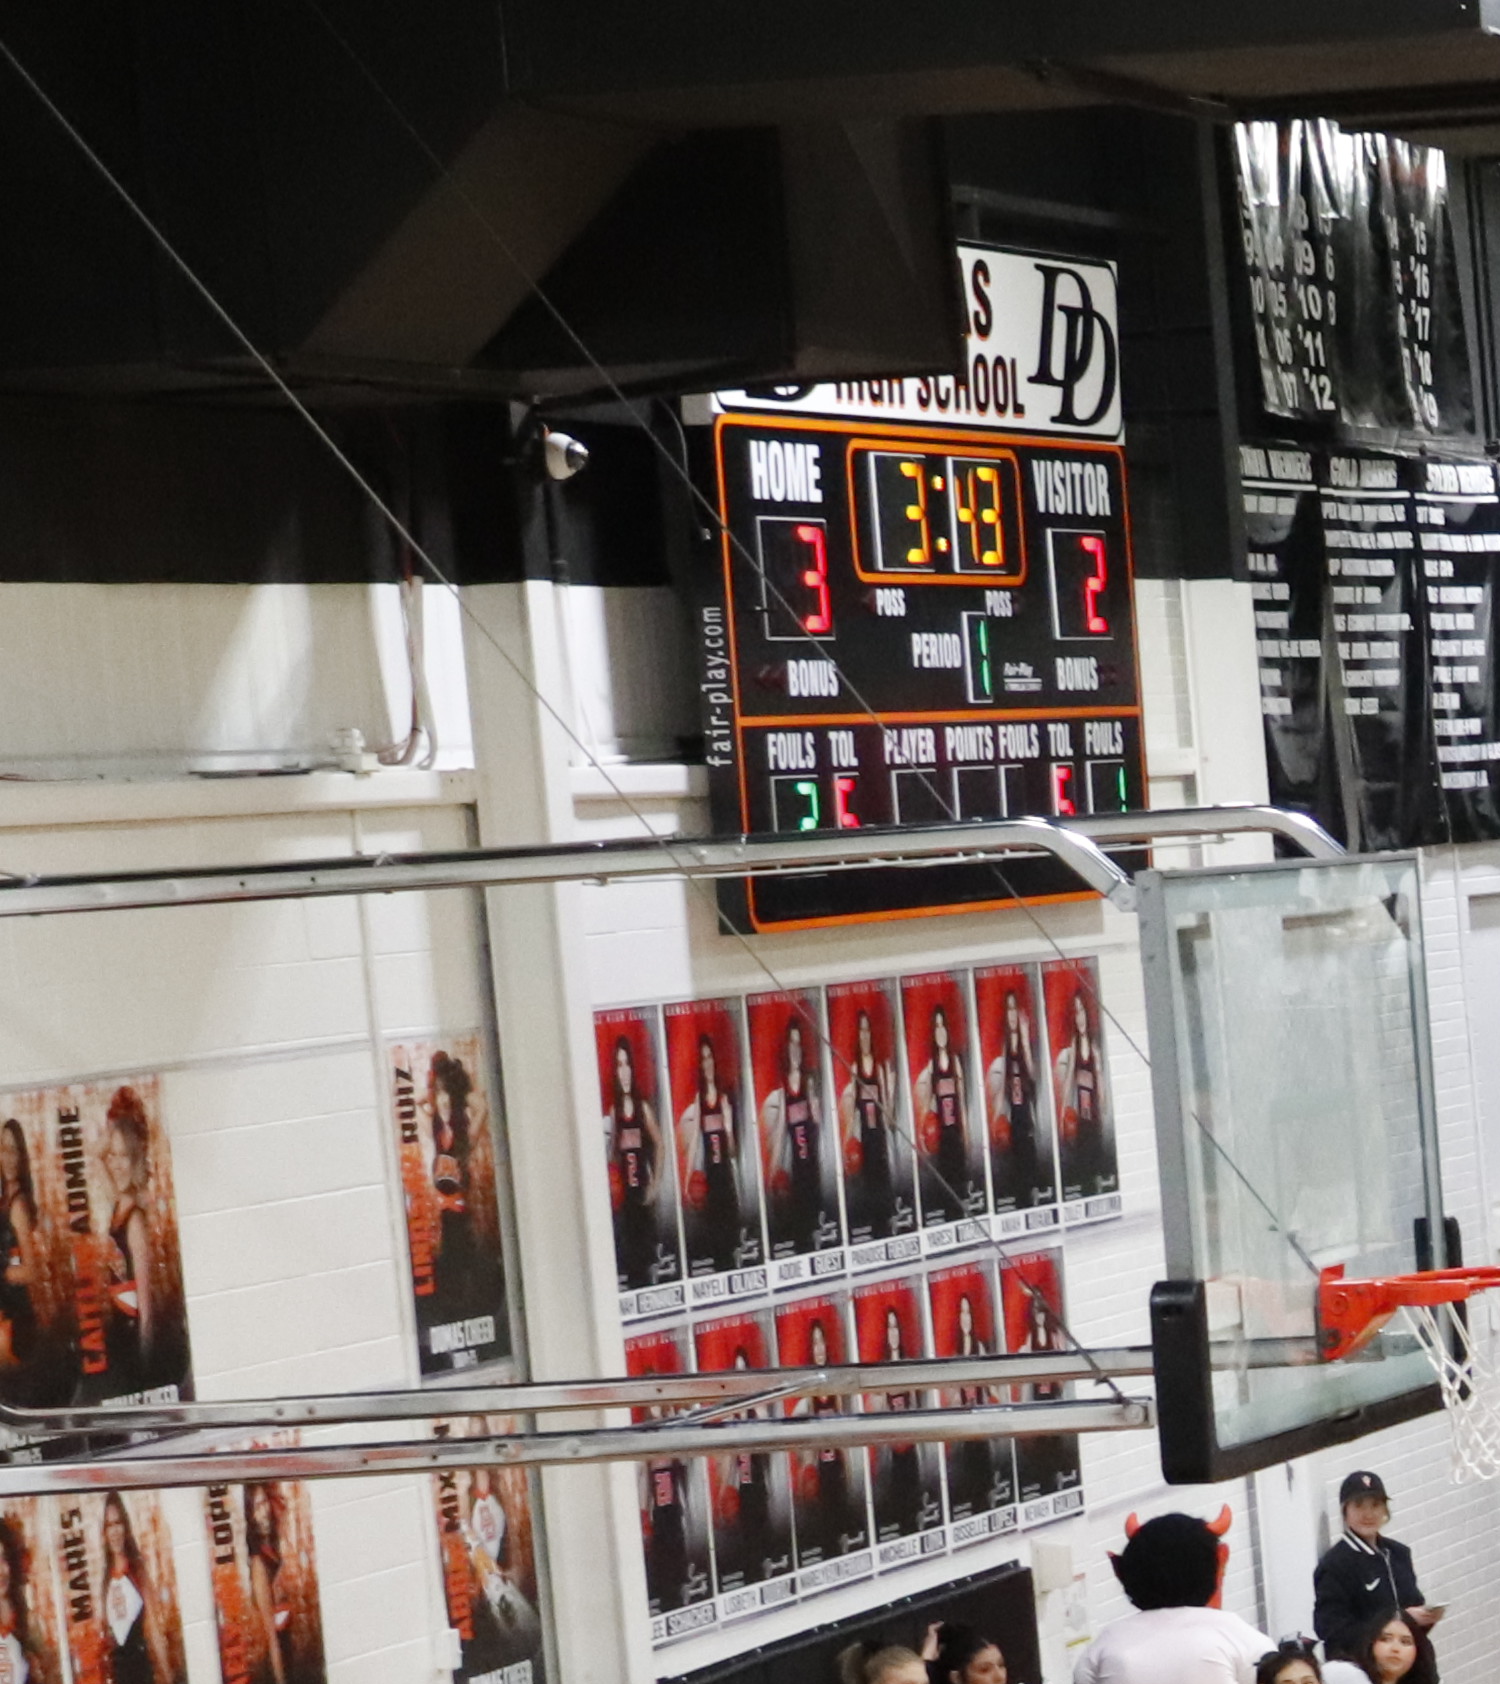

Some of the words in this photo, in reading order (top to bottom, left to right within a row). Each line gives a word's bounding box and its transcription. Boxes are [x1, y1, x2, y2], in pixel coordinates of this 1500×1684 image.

[1292, 277, 1323, 321] '10
[1409, 254, 1430, 300] '16
[1410, 299, 1431, 341] '17
[1297, 323, 1326, 368] '11
[1302, 366, 1337, 411] '12
[749, 440, 822, 503] HOME
[899, 461, 1004, 566] 3:43
[1032, 458, 1112, 517] VISITOR
[797, 525, 832, 633] 3
[1081, 536, 1108, 632] 2
[876, 588, 906, 617] POSS
[985, 589, 1014, 617] POSS
[911, 632, 962, 669] PERIOD
[701, 605, 734, 768] fair-play.com
[786, 659, 839, 697] BONUS
[1055, 657, 1099, 691] BONUS
[767, 732, 816, 769] FOULS
[828, 730, 859, 767] TOL
[884, 727, 936, 764] PLAYER
[945, 725, 994, 761] POINTS
[999, 723, 1040, 759] FOULS
[1048, 723, 1074, 757] TOL
[1085, 721, 1123, 756] FOULS
[395, 1066, 420, 1145] RUIZ
[56, 1104, 93, 1235] ADMIRE
[431, 1321, 466, 1355] DUMAS
[465, 1315, 496, 1348] CHEER
[203, 1483, 235, 1566] LOPE
[61, 1505, 95, 1623] MARES
